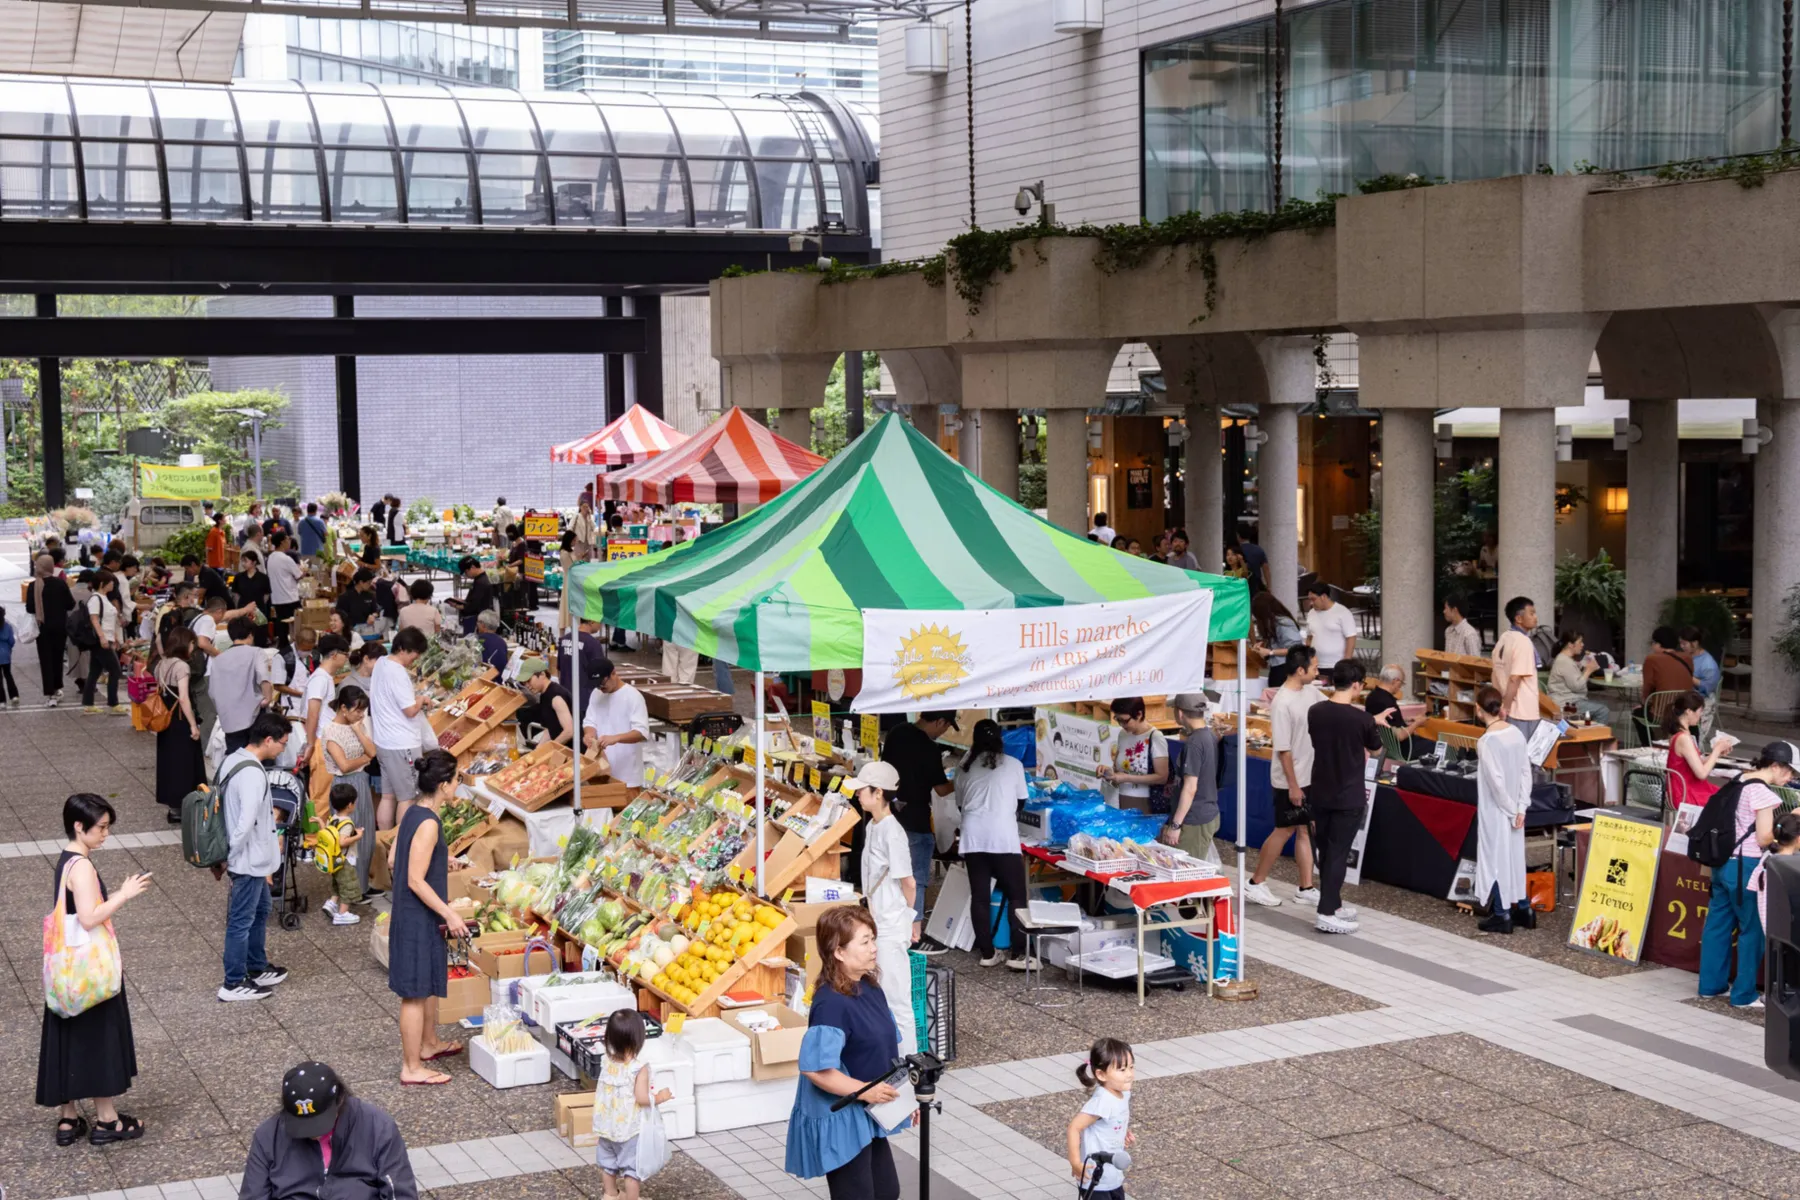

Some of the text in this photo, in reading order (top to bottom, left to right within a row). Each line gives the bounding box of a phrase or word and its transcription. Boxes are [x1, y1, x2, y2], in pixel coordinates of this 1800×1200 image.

[527, 523, 554, 532] ワイン
[1019, 622, 1069, 649] Hills
[1029, 657, 1045, 672] in
[1051, 651, 1089, 669] ARK
[1024, 675, 1084, 693] Saturday
[1591, 892, 1634, 912] 2 Terres
[1667, 899, 1687, 940] 2
